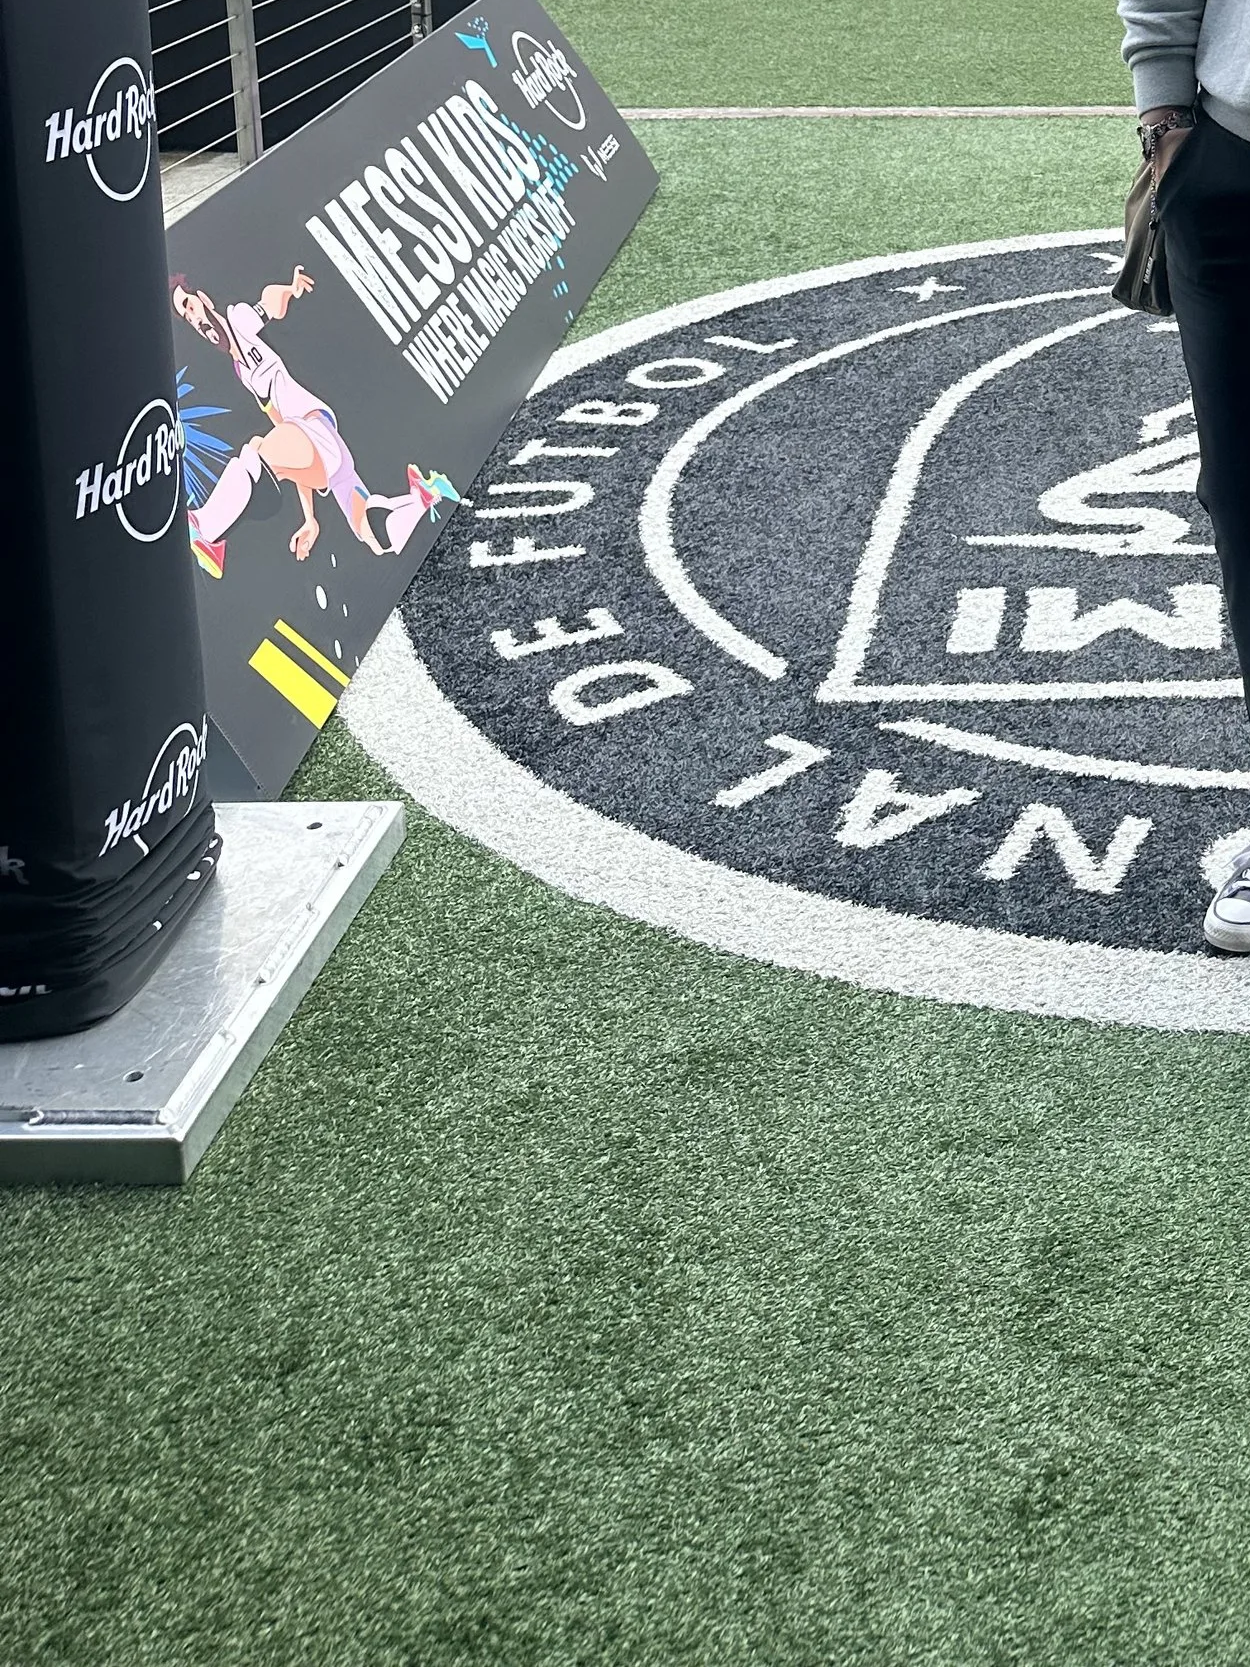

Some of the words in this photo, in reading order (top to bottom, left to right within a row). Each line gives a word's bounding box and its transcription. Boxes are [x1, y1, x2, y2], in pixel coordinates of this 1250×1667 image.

[44, 89, 123, 163] Hard
[125, 69, 157, 140] Rock
[511, 55, 553, 109] Hard
[534, 39, 578, 92] Rock
[305, 136, 485, 346] MESSI
[416, 79, 541, 231] KIDS
[401, 291, 491, 405] WHERE
[456, 243, 527, 338] MAGIC
[496, 202, 558, 285] KICKS
[531, 178, 577, 241] OFF
[247, 346, 263, 367] 10
[74, 434, 153, 520] Hard
[155, 400, 187, 476] Rock
[462, 333, 799, 570] FUTBOL
[490, 605, 695, 727] DE
[98, 761, 175, 858] Hard
[176, 713, 208, 798] Rock
